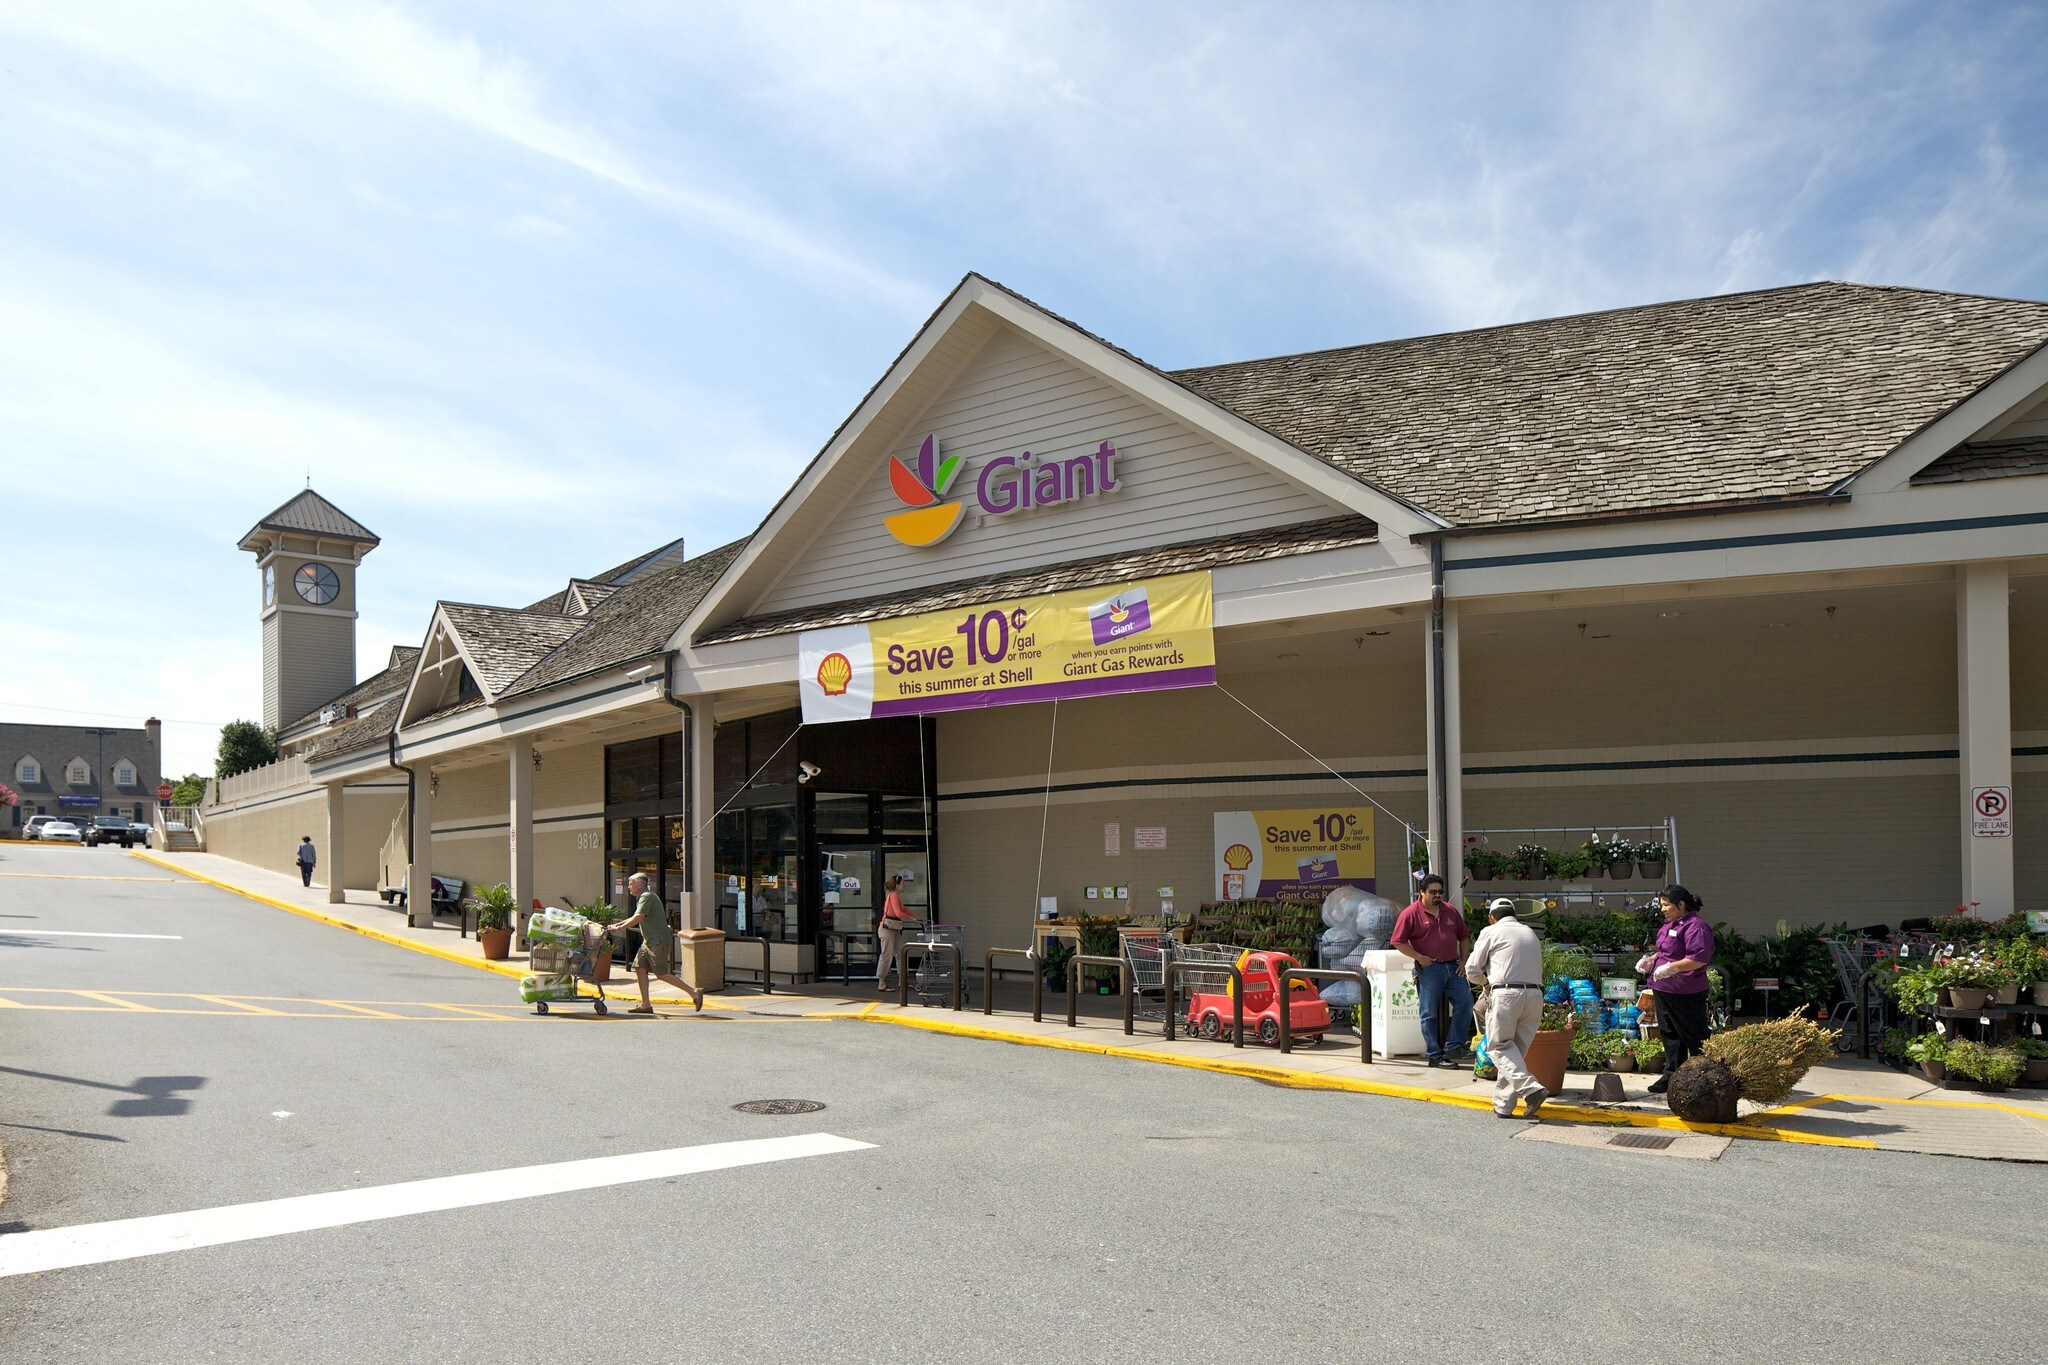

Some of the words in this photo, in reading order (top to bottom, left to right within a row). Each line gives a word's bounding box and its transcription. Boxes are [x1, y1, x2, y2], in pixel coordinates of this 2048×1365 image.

[976, 439, 1119, 515] Giant
[1110, 622, 1134, 636] Giant
[1012, 632, 1035, 651] /gal
[1071, 650, 1093, 660] when
[1093, 649, 1108, 659] you
[1109, 646, 1127, 656] earn
[1128, 643, 1153, 654] points
[1155, 639, 1173, 649] with
[887, 643, 954, 675] Save
[1007, 652, 1017, 661] or
[1018, 650, 1042, 660] more
[1063, 662, 1098, 677] Giant
[1101, 658, 1125, 672] Gas
[1128, 649, 1184, 670] Rewards
[898, 680, 922, 695] this
[925, 675, 979, 692] summer
[982, 672, 996, 686] at
[999, 666, 1033, 684] Shell
[157, 788, 172, 796] STOP
[1974, 821, 1989, 829] FIRE
[1991, 821, 2009, 829] LANE
[577, 832, 600, 850] 9812
[1266, 826, 1311, 843] Save
[1274, 844, 1290, 852] this
[1340, 843, 1362, 851] Shell
[1311, 871, 1328, 879] Giant
[1276, 890, 1301, 900] Giant
[1302, 890, 1320, 900] Gas
